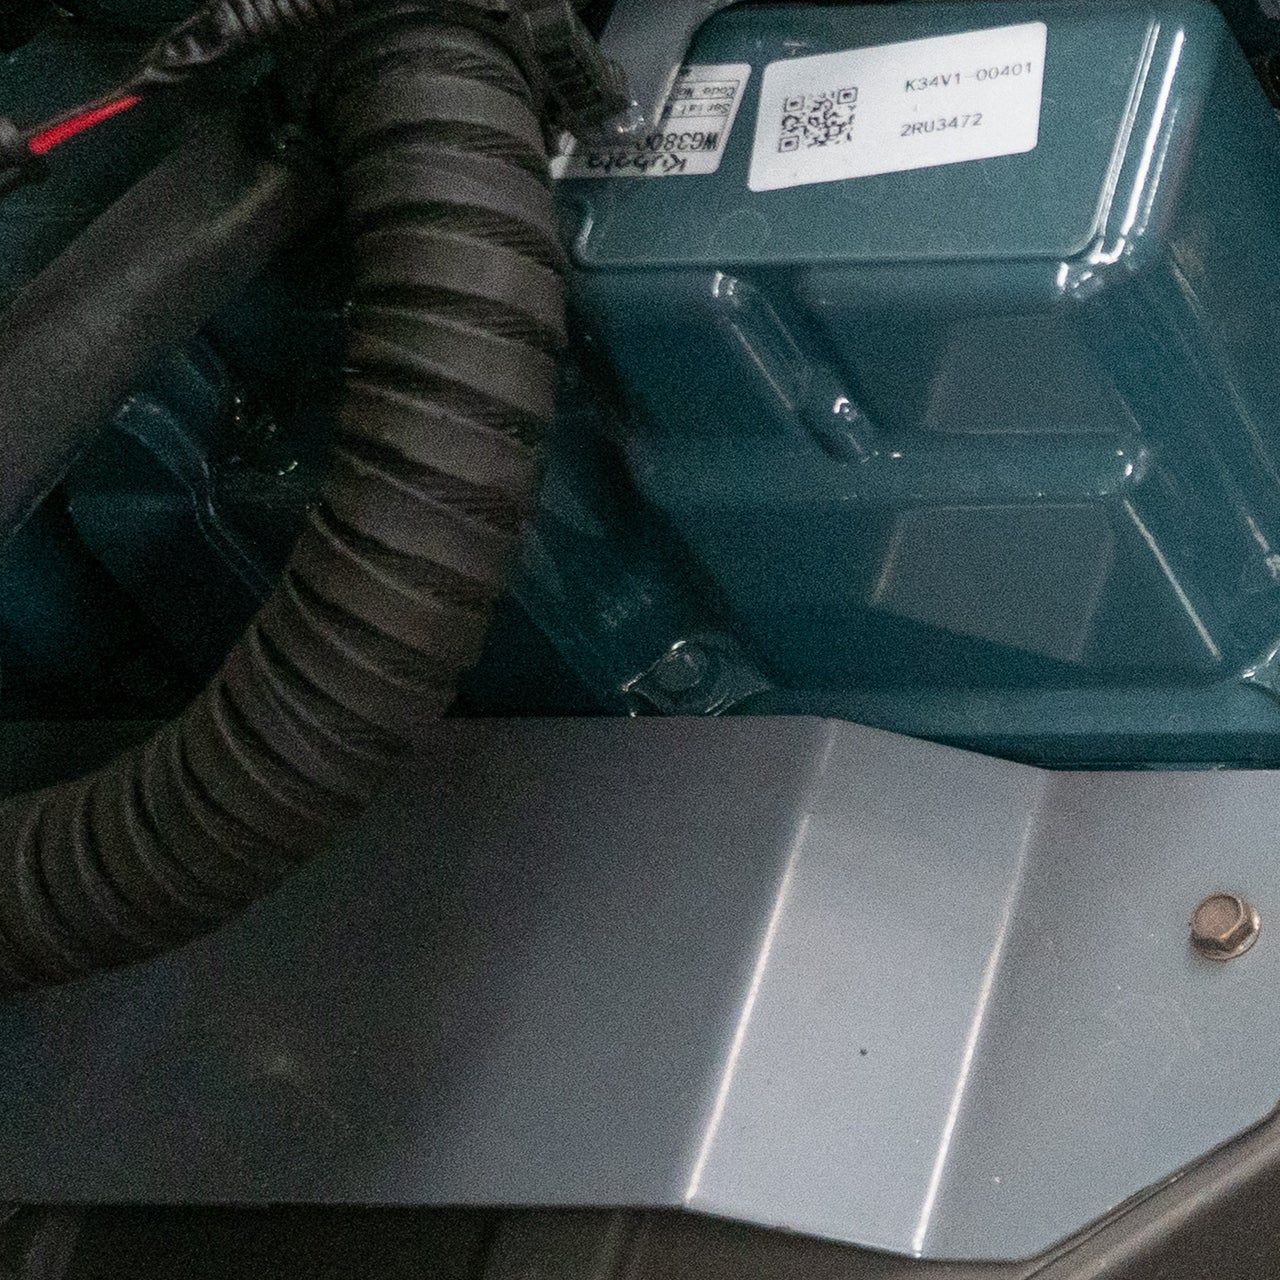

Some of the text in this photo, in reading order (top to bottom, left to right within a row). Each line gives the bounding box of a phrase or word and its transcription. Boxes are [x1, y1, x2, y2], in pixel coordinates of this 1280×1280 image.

[905, 61, 1032, 93] K34V1-00401
[901, 114, 982, 138] 2RU3472
[587, 154, 686, 173] Kubota
